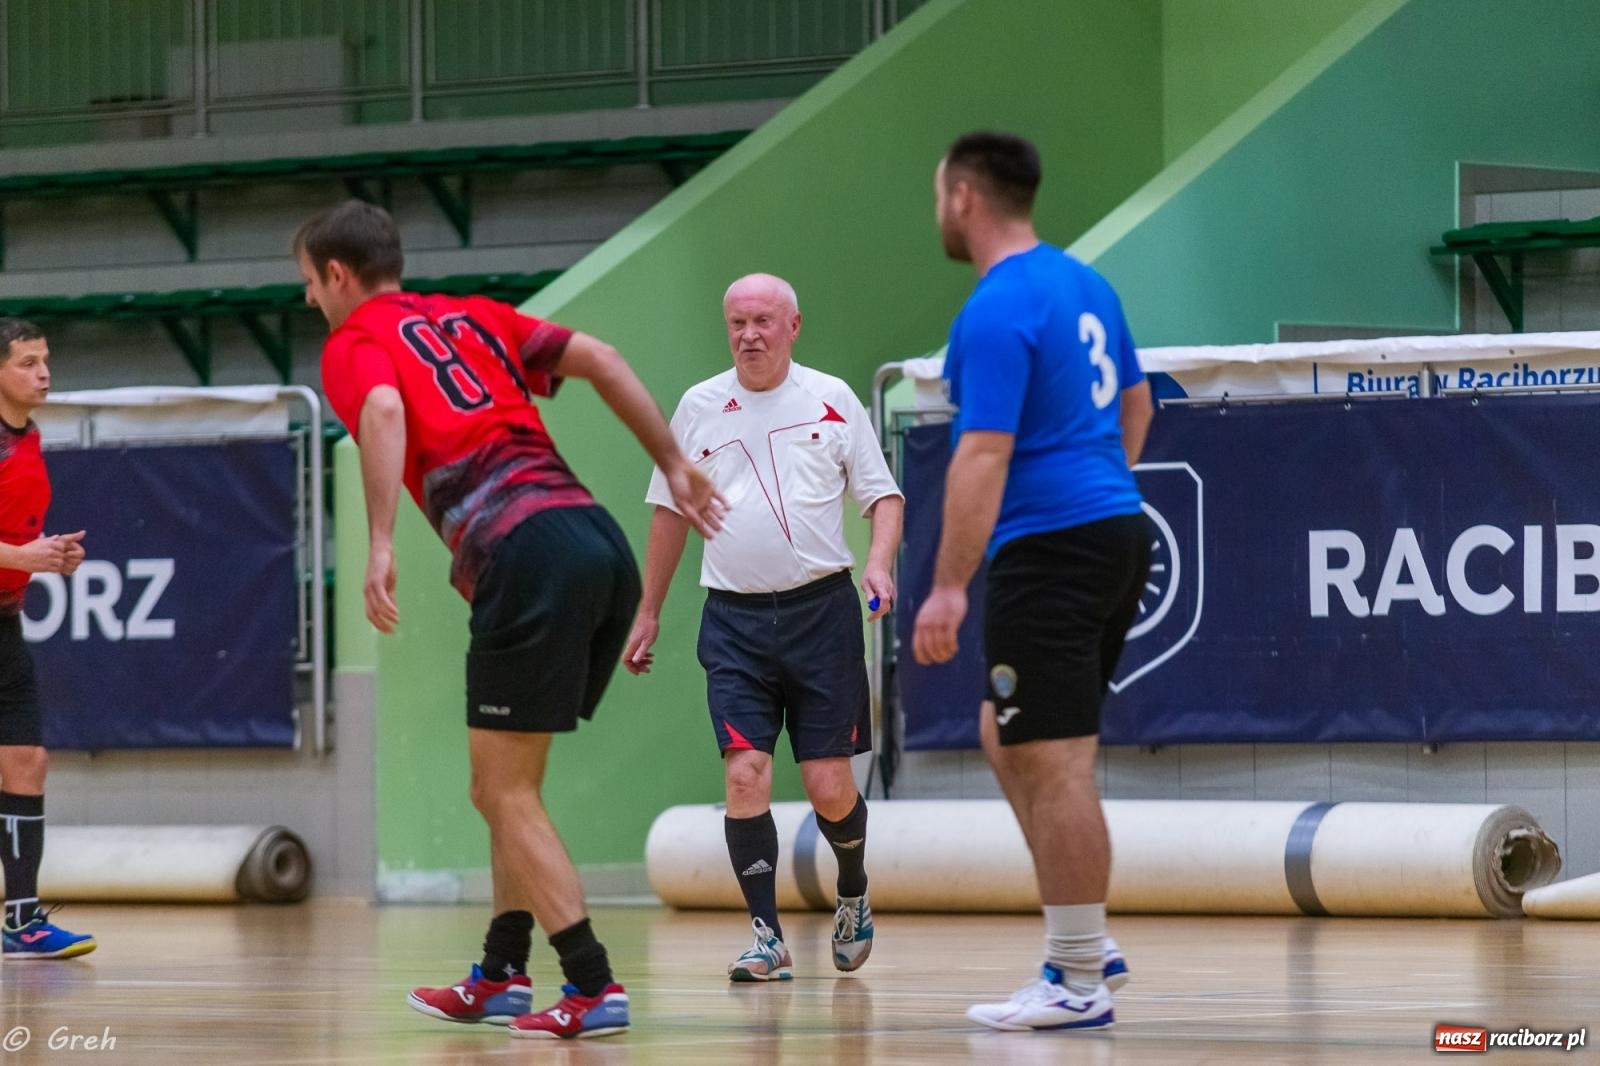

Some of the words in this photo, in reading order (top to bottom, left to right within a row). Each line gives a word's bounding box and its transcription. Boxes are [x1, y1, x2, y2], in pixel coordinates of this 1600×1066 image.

[1078, 311, 1118, 410] 3
[1347, 369, 1420, 398] Biura
[1308, 524, 1600, 618] RACIB
